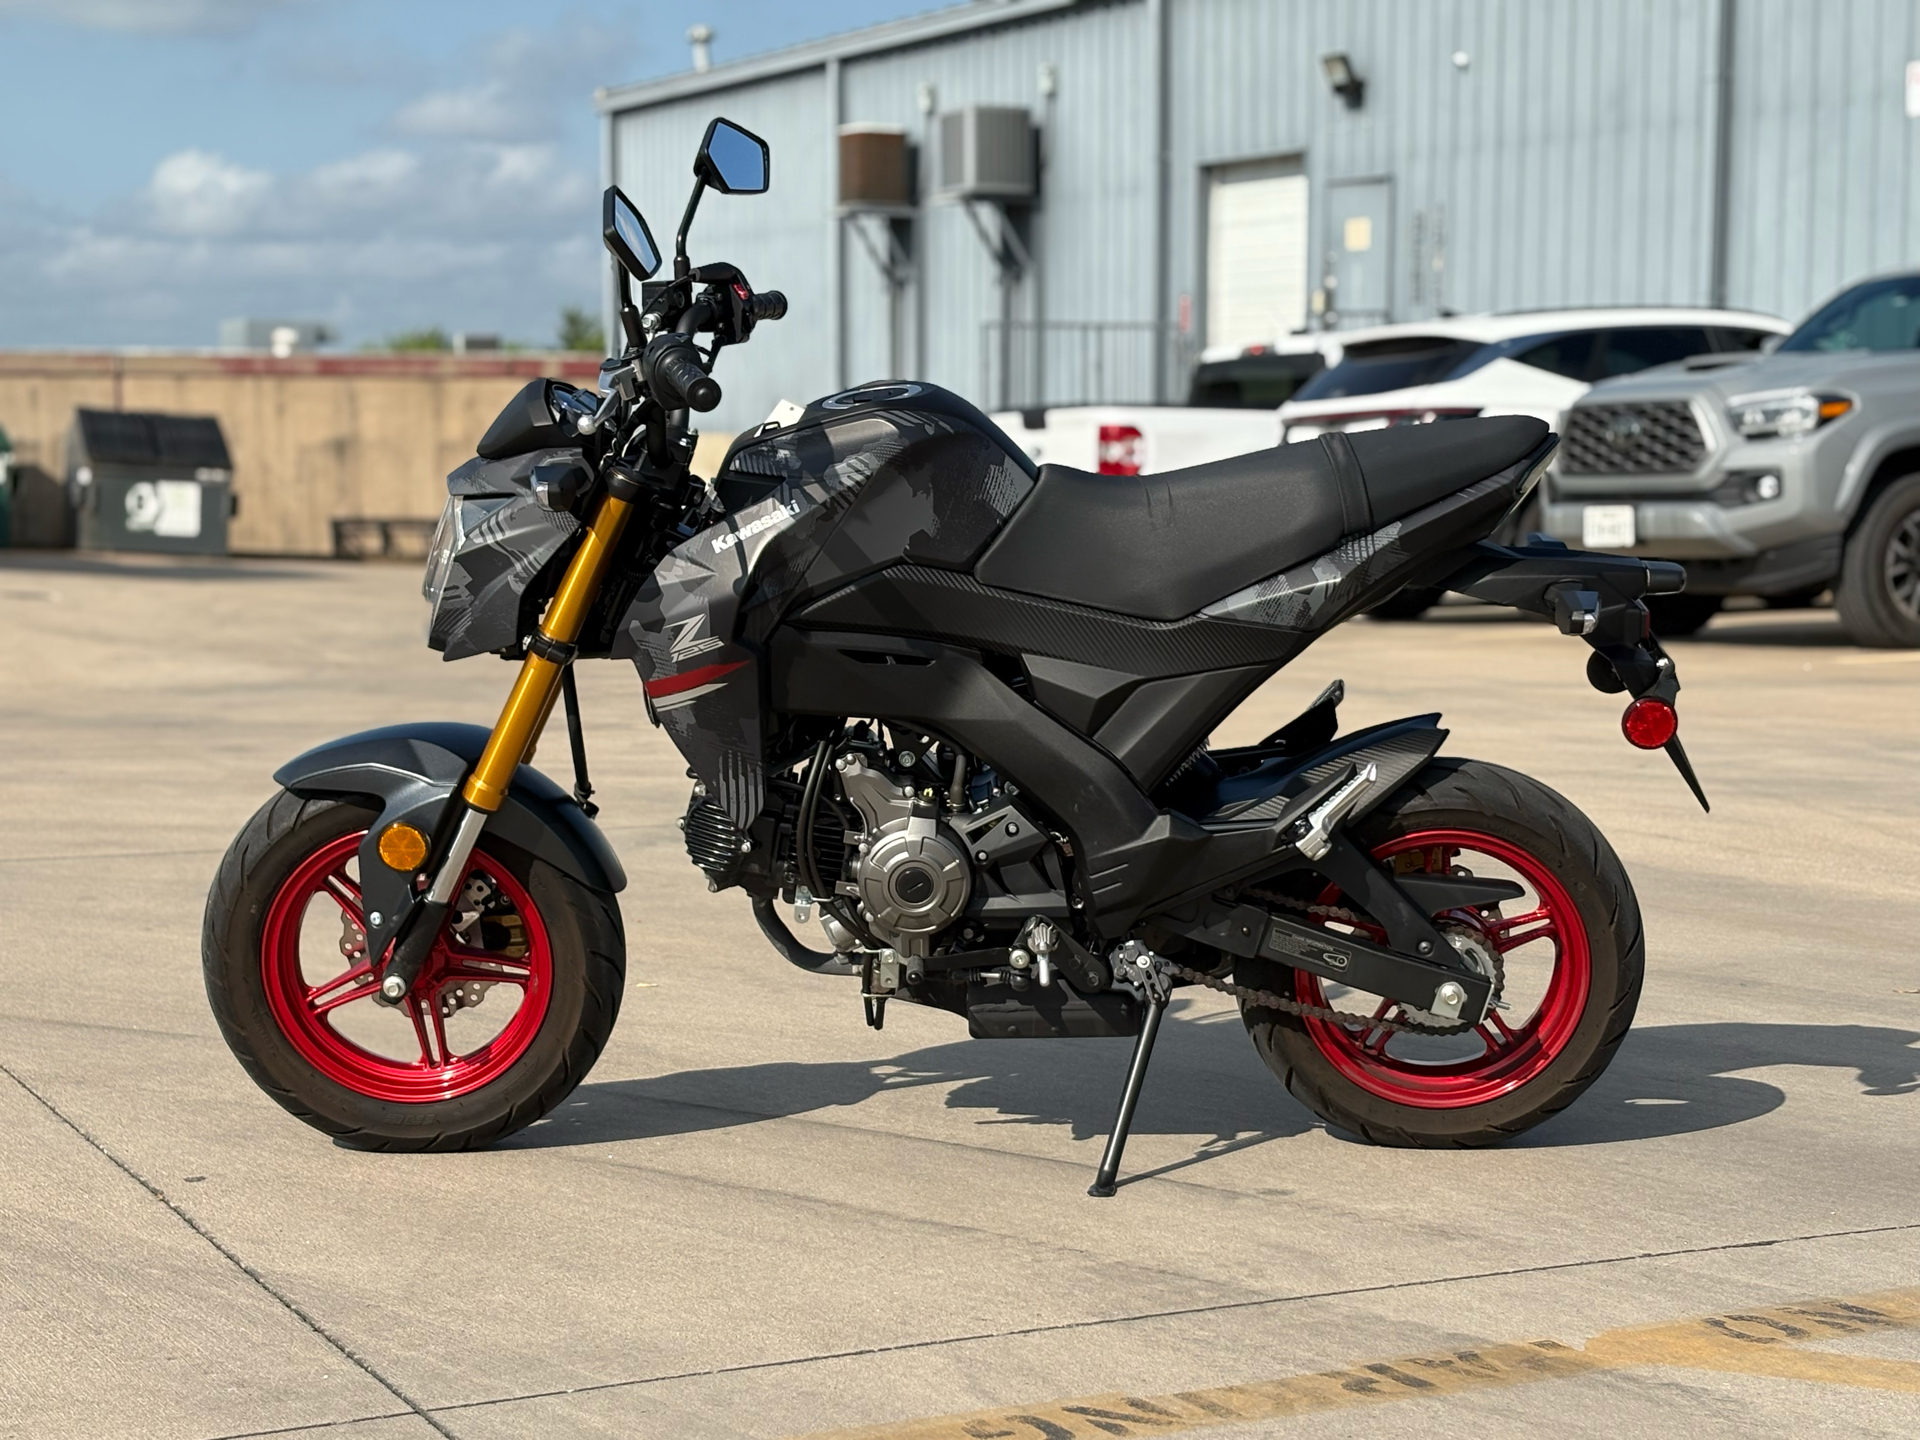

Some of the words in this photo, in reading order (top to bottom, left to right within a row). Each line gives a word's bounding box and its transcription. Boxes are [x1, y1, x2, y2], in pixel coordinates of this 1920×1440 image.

[711, 500, 801, 554] Kawasaki
[670, 639, 725, 663] 125
[960, 1338, 1588, 1440] ARING
